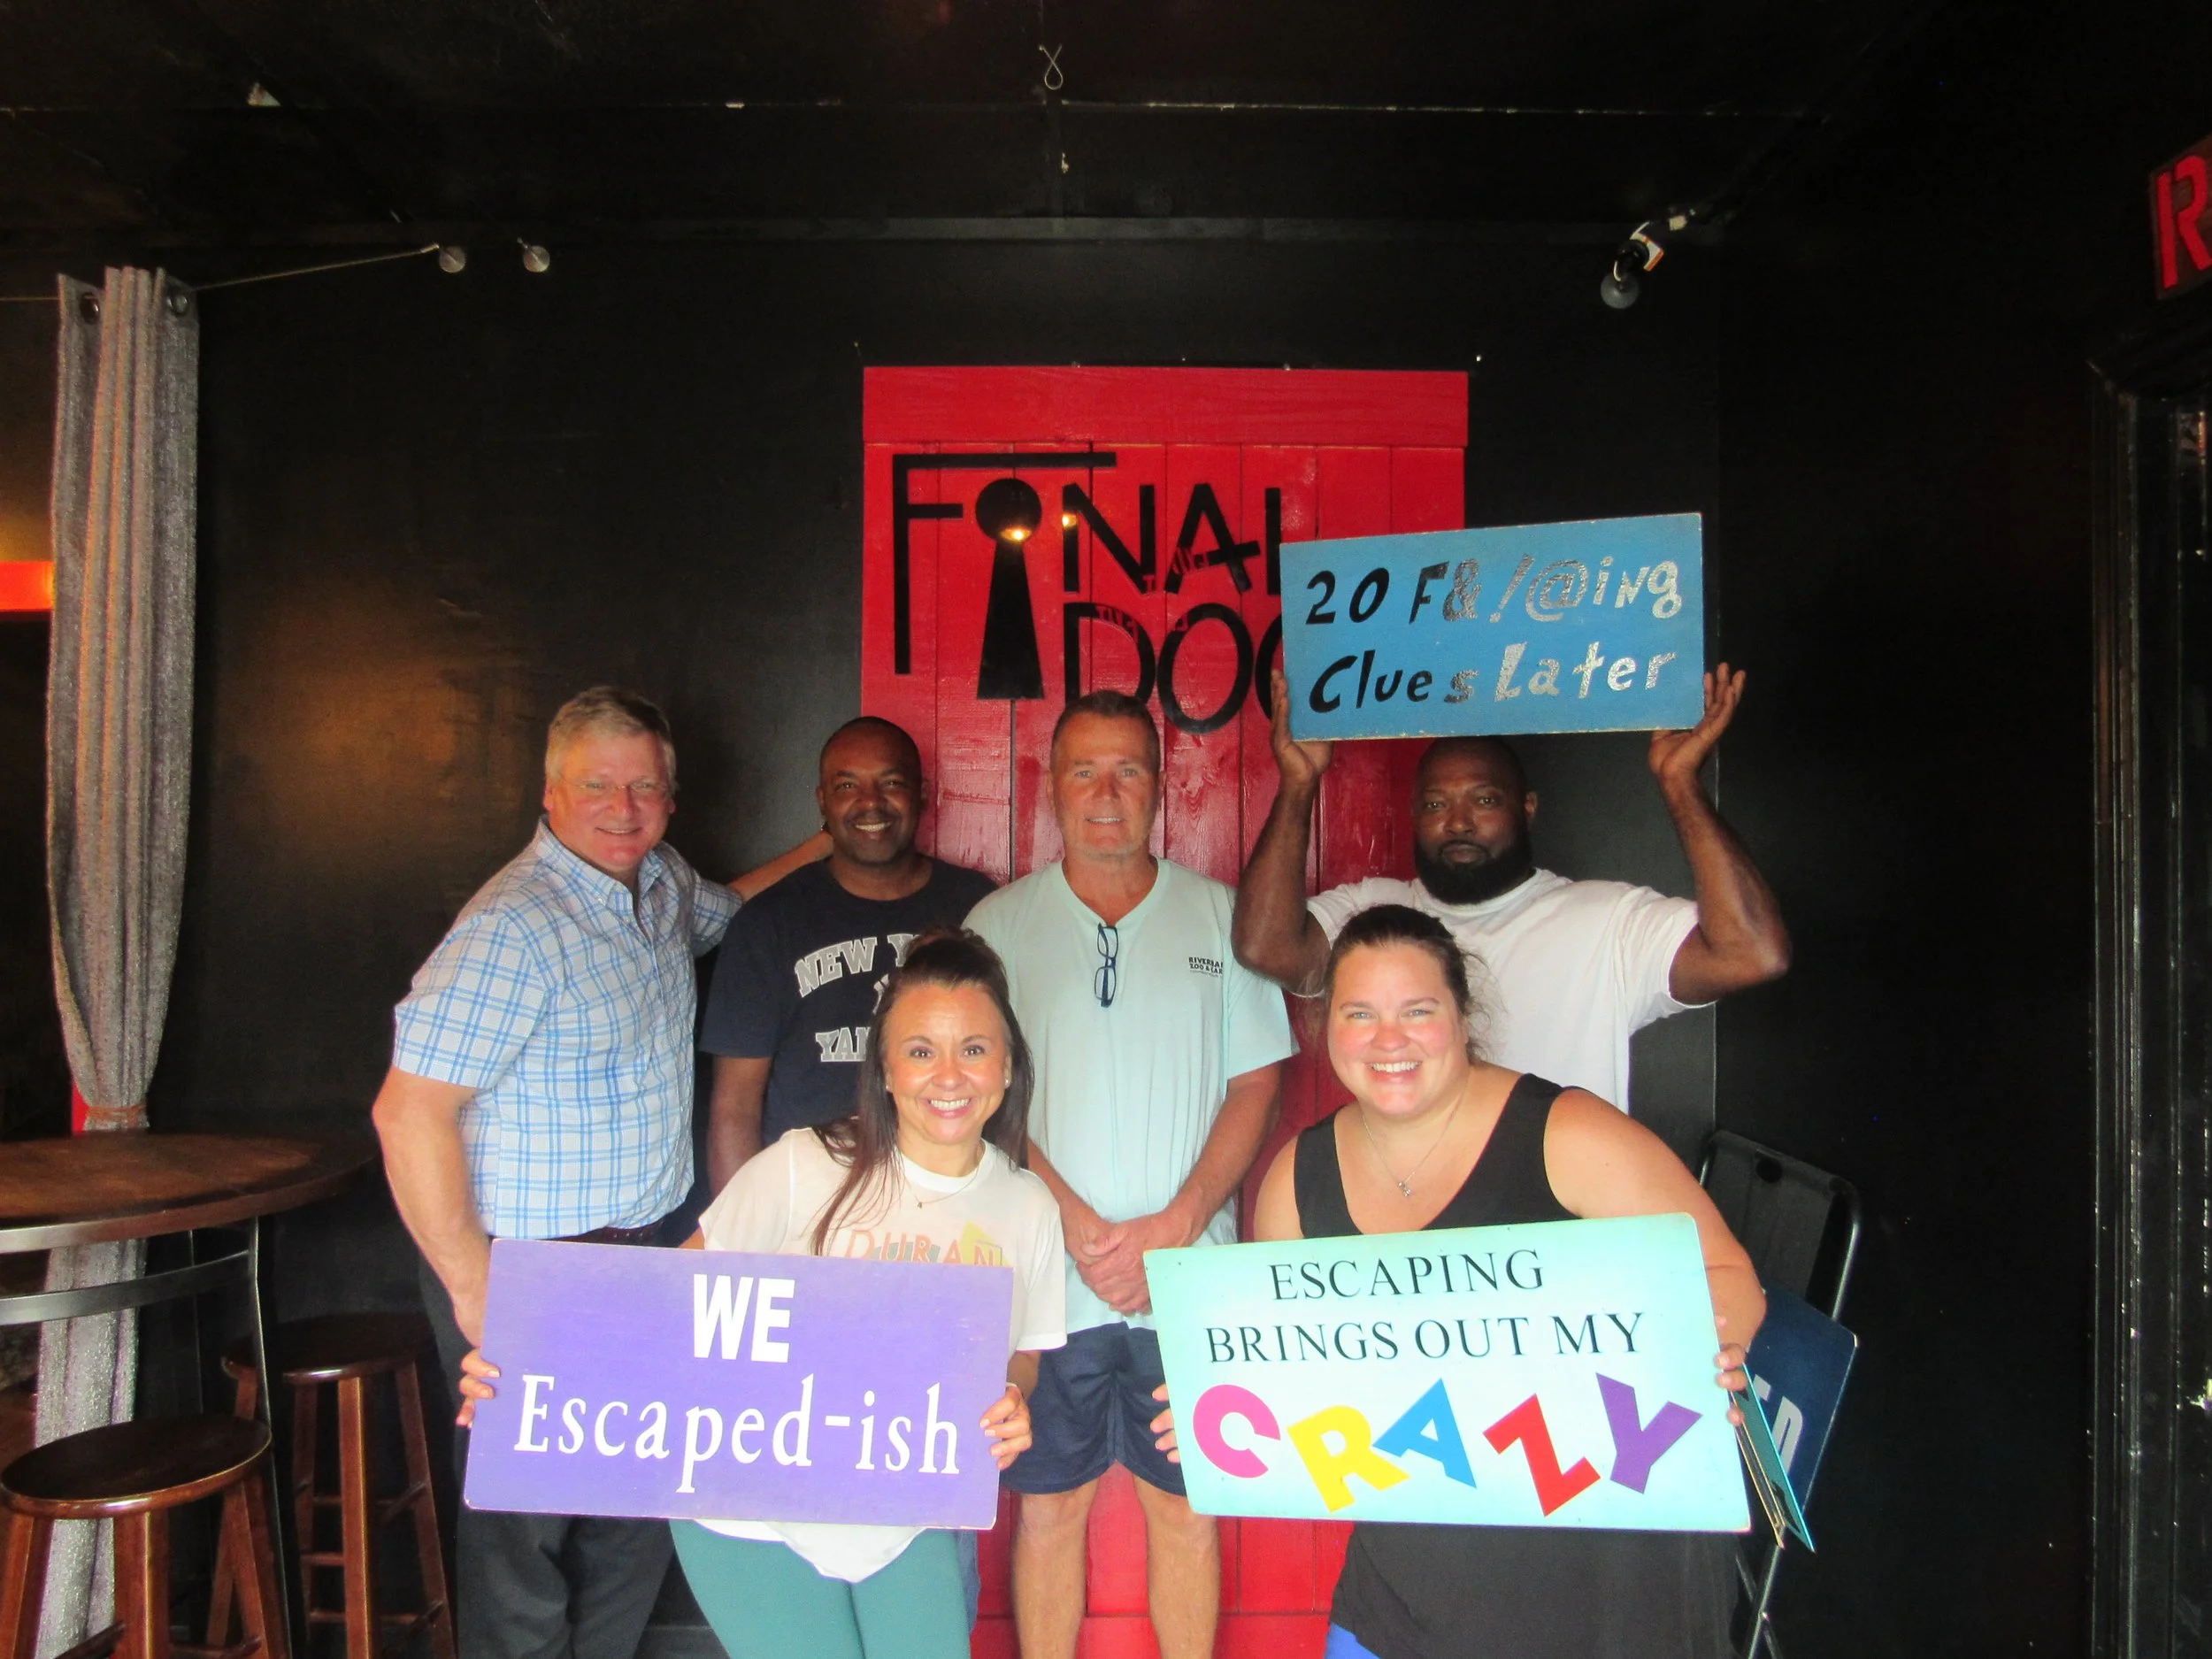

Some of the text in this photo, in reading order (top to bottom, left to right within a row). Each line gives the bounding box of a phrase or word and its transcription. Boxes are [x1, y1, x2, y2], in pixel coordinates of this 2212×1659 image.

[1305, 567, 1389, 626] 20
[1309, 641, 1677, 713] Clues Later
[795, 936, 878, 998] NEW
[1268, 1248, 1545, 1302] ESCAPING
[693, 1274, 795, 1363] WE
[1205, 1311, 1644, 1363] BRINGS OUT MY
[513, 1372, 960, 1494] Escaped-ish
[1192, 1371, 1703, 1518] CRAZY
